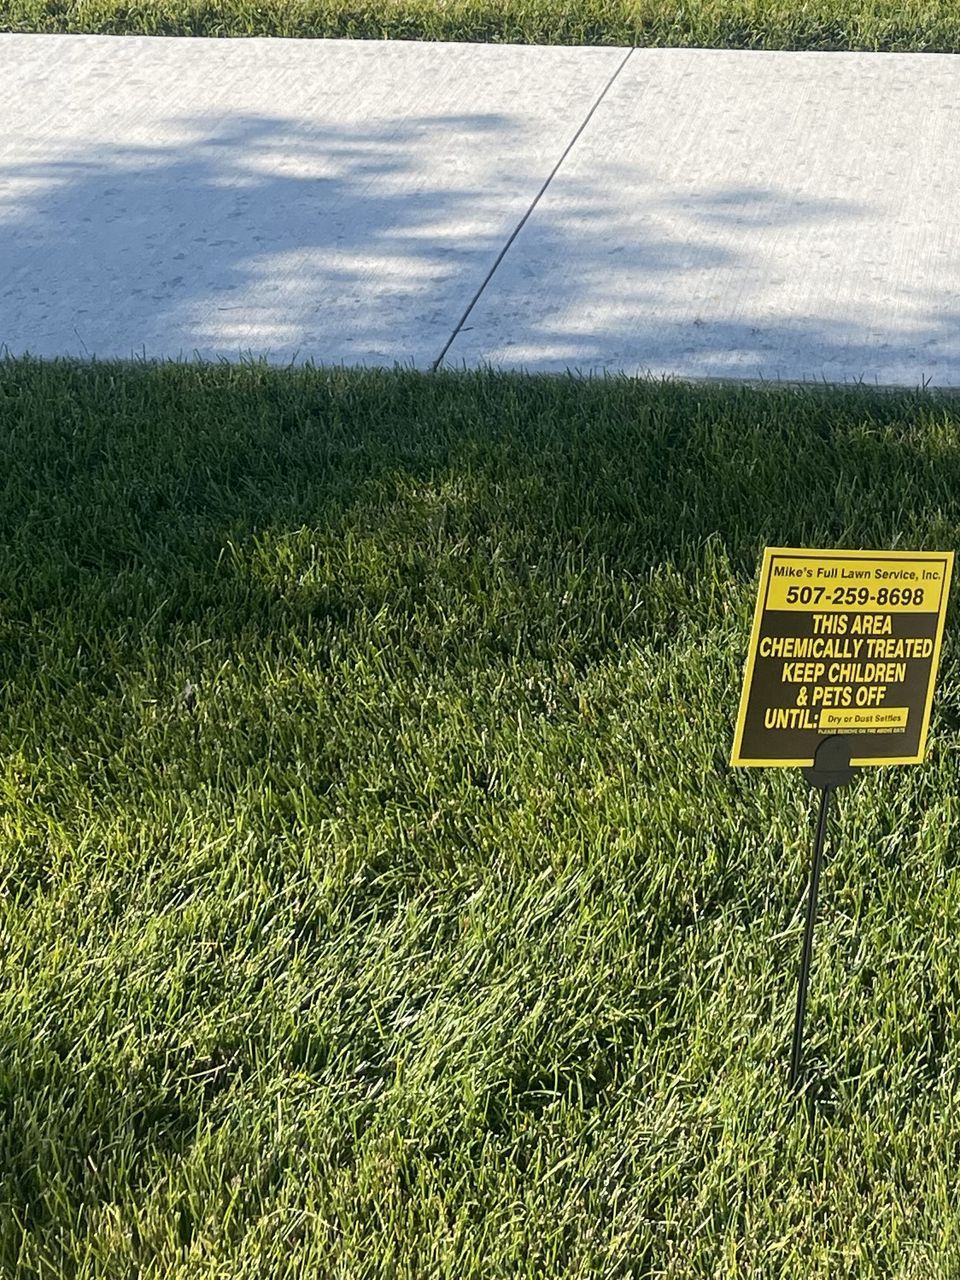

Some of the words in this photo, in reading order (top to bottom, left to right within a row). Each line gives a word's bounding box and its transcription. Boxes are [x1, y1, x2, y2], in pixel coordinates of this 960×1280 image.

[773, 566, 814, 578] Mike's
[816, 568, 838, 579] Full
[841, 568, 871, 580] Lawn
[875, 569, 919, 581] Service,
[921, 570, 941, 580] Inc.
[786, 586, 925, 606] 507-259-8698
[812, 614, 849, 635] THIS
[850, 615, 892, 635] AREA
[759, 637, 863, 658] CHEMICALLY
[866, 638, 933, 658] TREATED
[781, 662, 825, 682] KEEP
[828, 663, 906, 682] CHILDREN
[796, 686, 808, 706] &
[812, 686, 852, 706] PETS
[855, 686, 887, 705] OFF
[764, 708, 819, 729] UNTIL:
[827, 714, 841, 724] Dry
[854, 714, 873, 723] Dust
